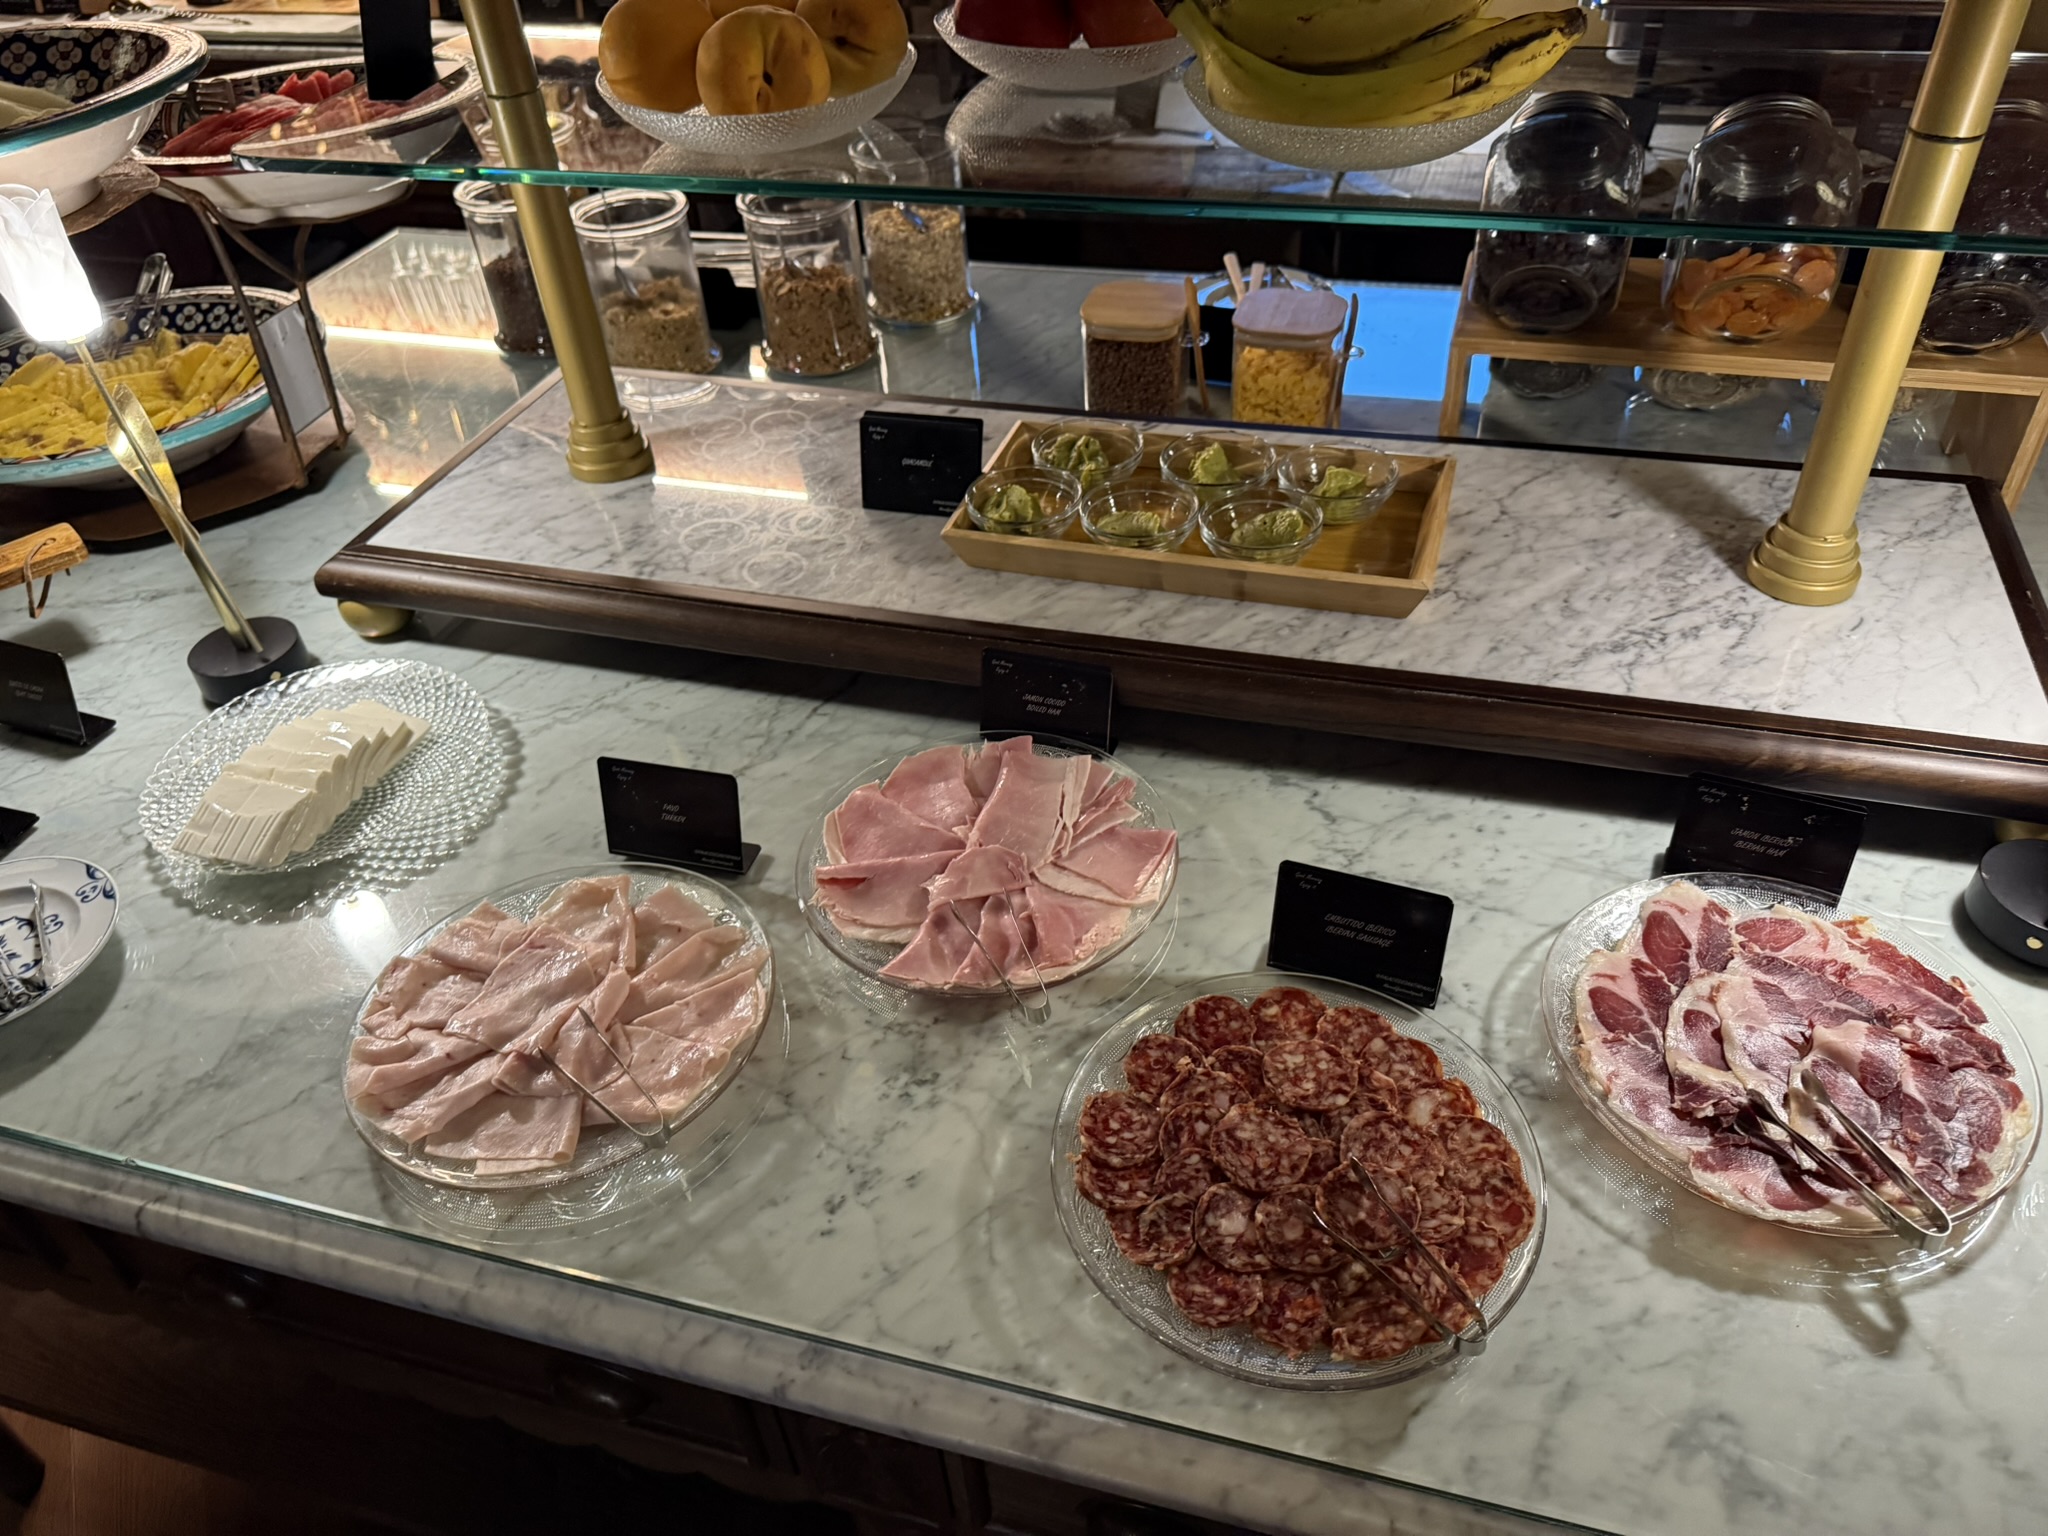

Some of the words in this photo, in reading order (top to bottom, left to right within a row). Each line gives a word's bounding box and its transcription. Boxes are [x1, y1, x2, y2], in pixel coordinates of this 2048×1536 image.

[1044, 698, 1066, 707] COCIDO
[1027, 704, 1047, 713] BOILED
[663, 804, 679, 812] PAVO
[662, 813, 686, 823] TURKEY
[1733, 841, 1766, 853] IBERIAN
[1766, 848, 1789, 857] HAM
[1325, 914, 1364, 929] EMBUTIDO
[1326, 926, 1356, 938] IBERIAN
[1357, 934, 1393, 948] SAUSAGE
